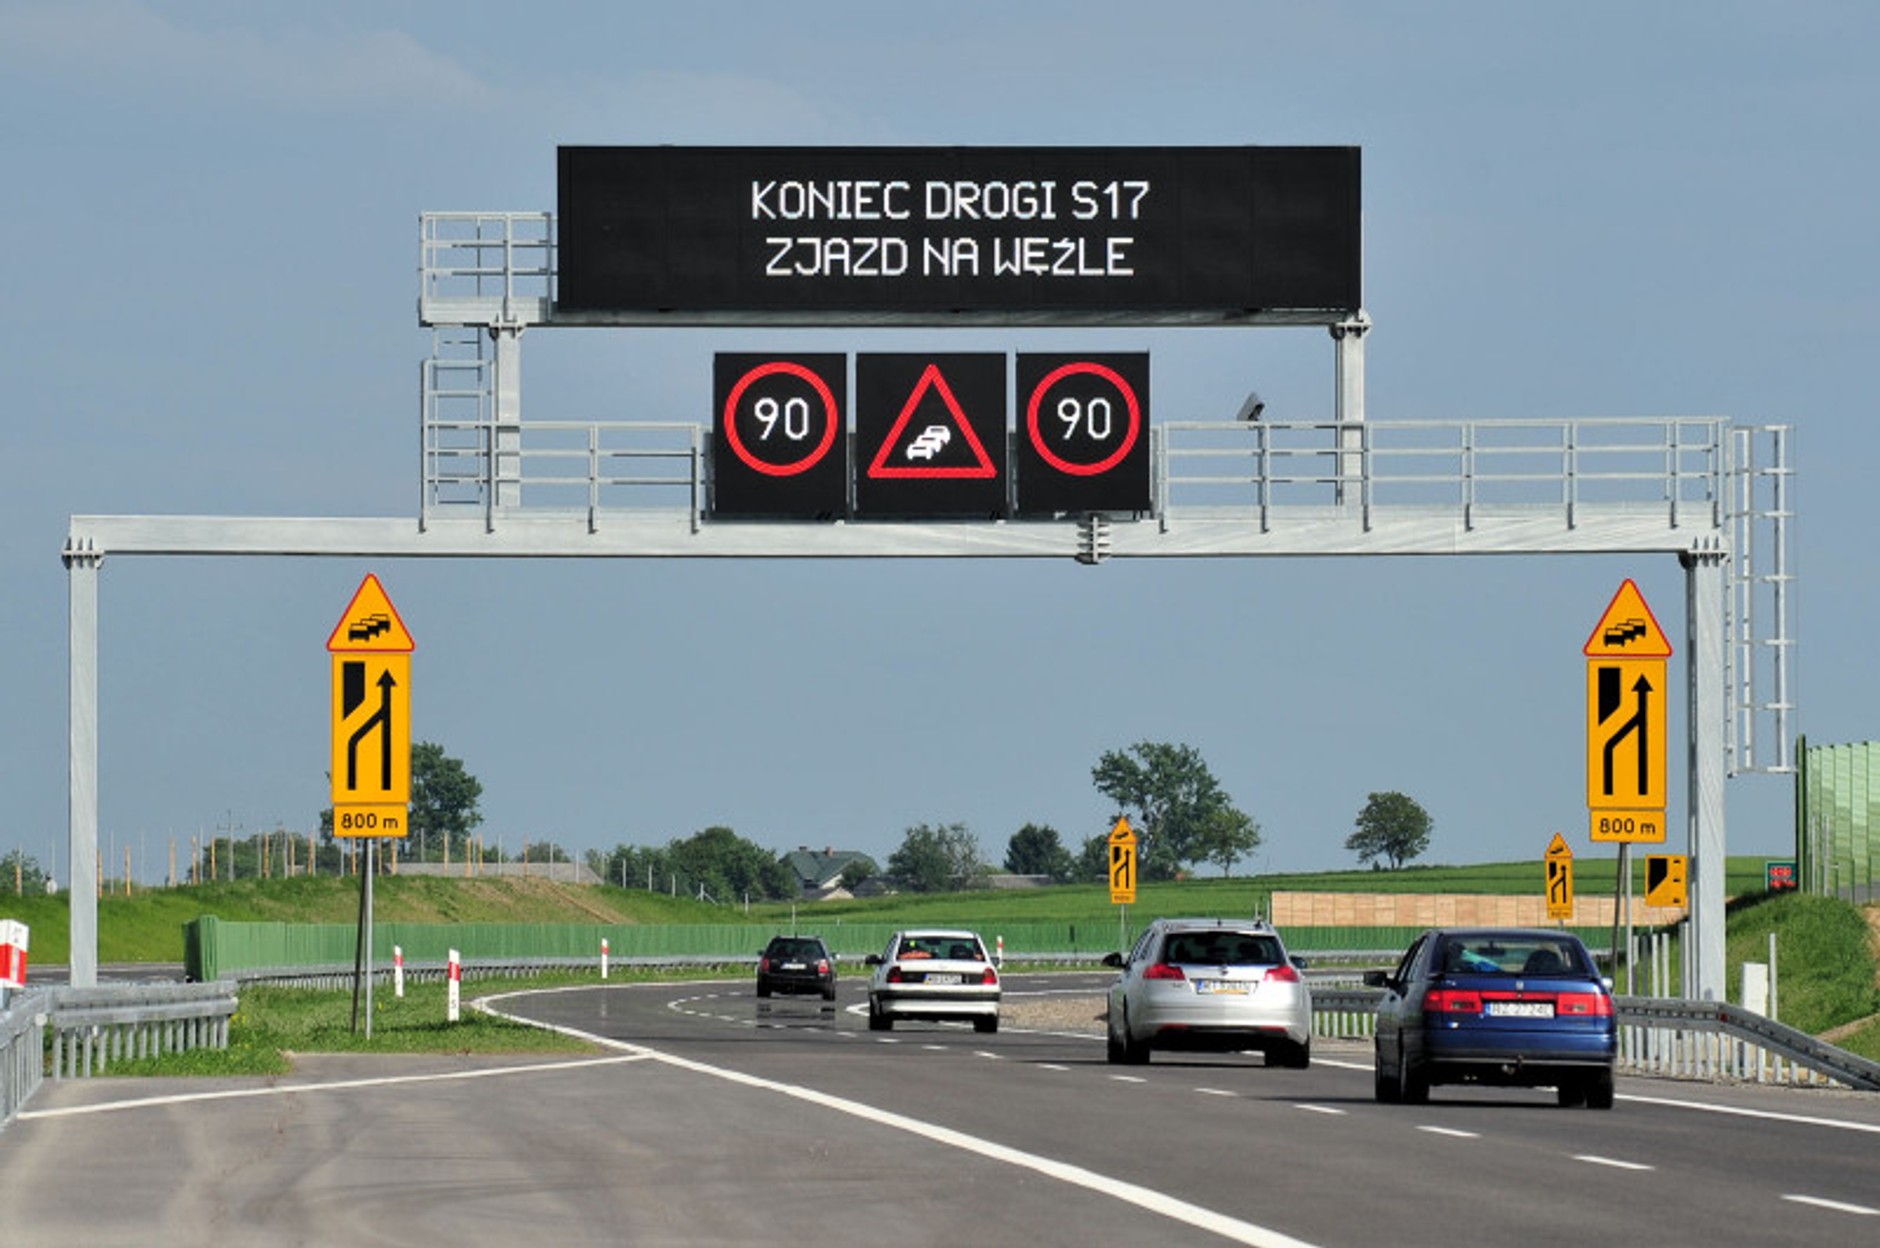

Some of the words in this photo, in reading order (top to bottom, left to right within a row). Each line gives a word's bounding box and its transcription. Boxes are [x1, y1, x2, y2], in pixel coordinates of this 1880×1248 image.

[751, 180, 911, 220] KONIEC
[925, 180, 1057, 220] DROGI
[1071, 180, 1150, 220] S17
[765, 237, 909, 277] ZJAZD
[923, 237, 979, 277] NA
[993, 237, 1134, 277] WĘŹLE
[754, 397, 809, 440] 90
[1057, 398, 1112, 440] 90
[341, 813, 377, 829] 800
[382, 817, 398, 829] m
[1599, 818, 1635, 835] 800
[1640, 822, 1656, 836] m
